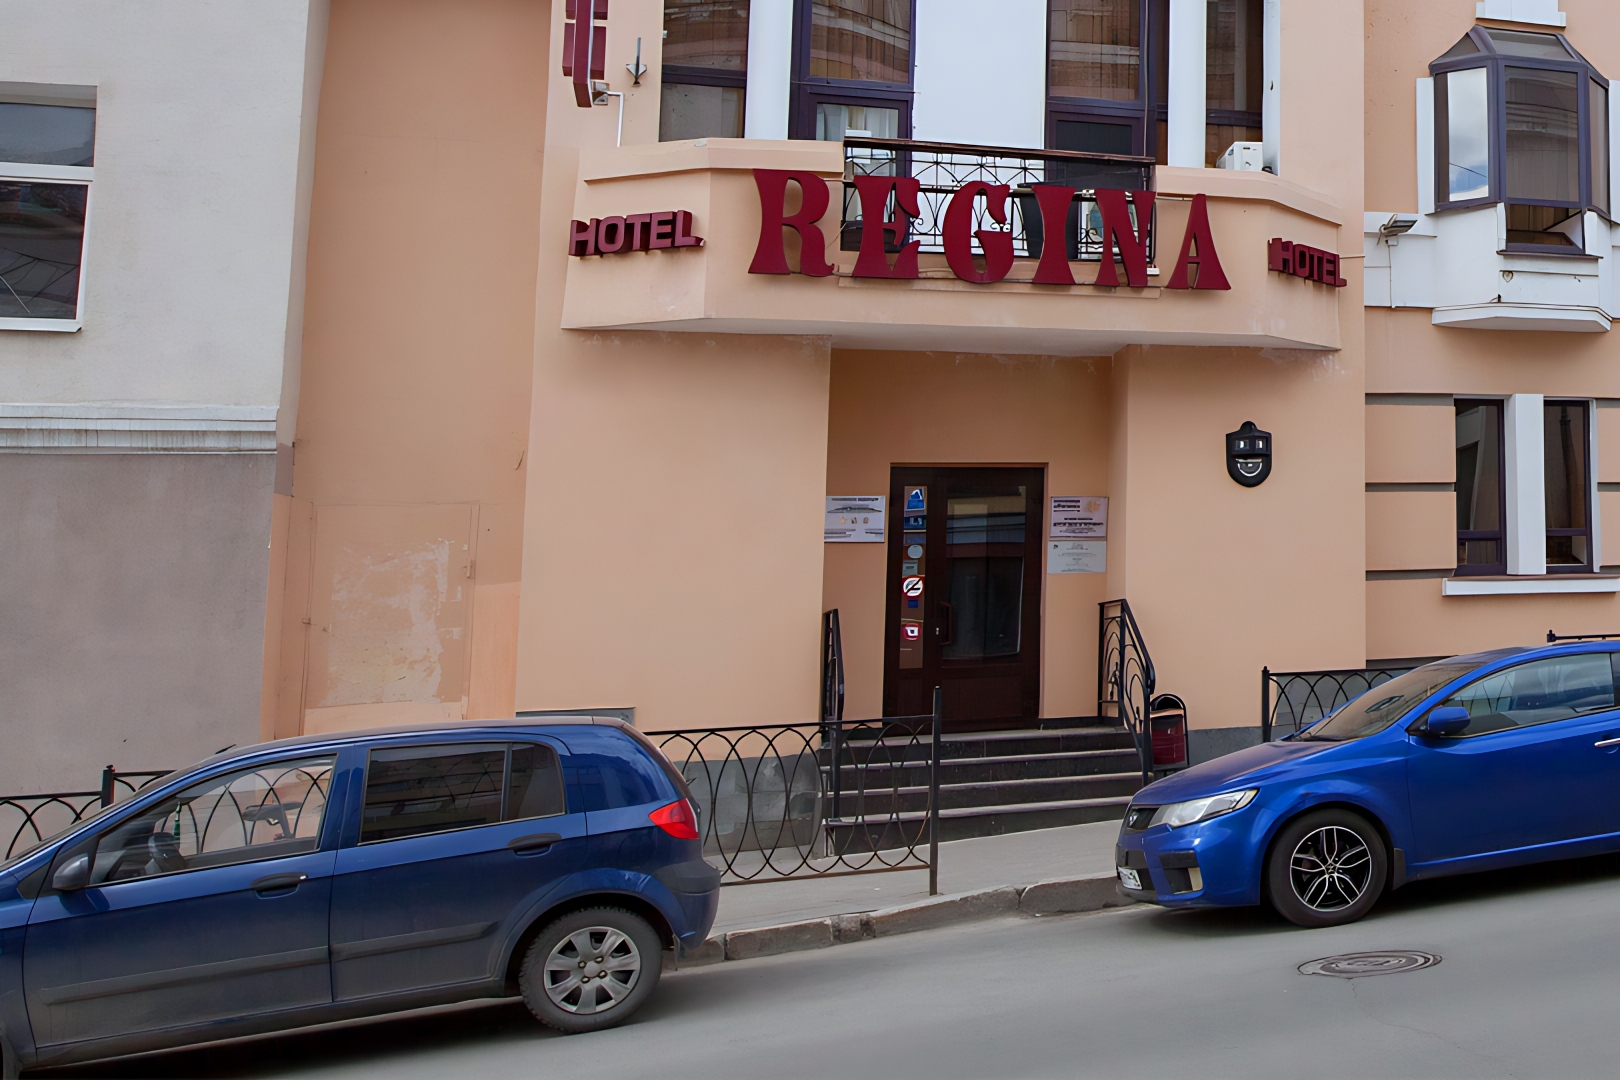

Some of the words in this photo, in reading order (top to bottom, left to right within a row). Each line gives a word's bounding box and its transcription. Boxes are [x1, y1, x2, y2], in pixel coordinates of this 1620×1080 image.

[569, 210, 705, 257] HOTEL
[748, 169, 1231, 290] REGINA
[1268, 237, 1347, 288] HOTEL
